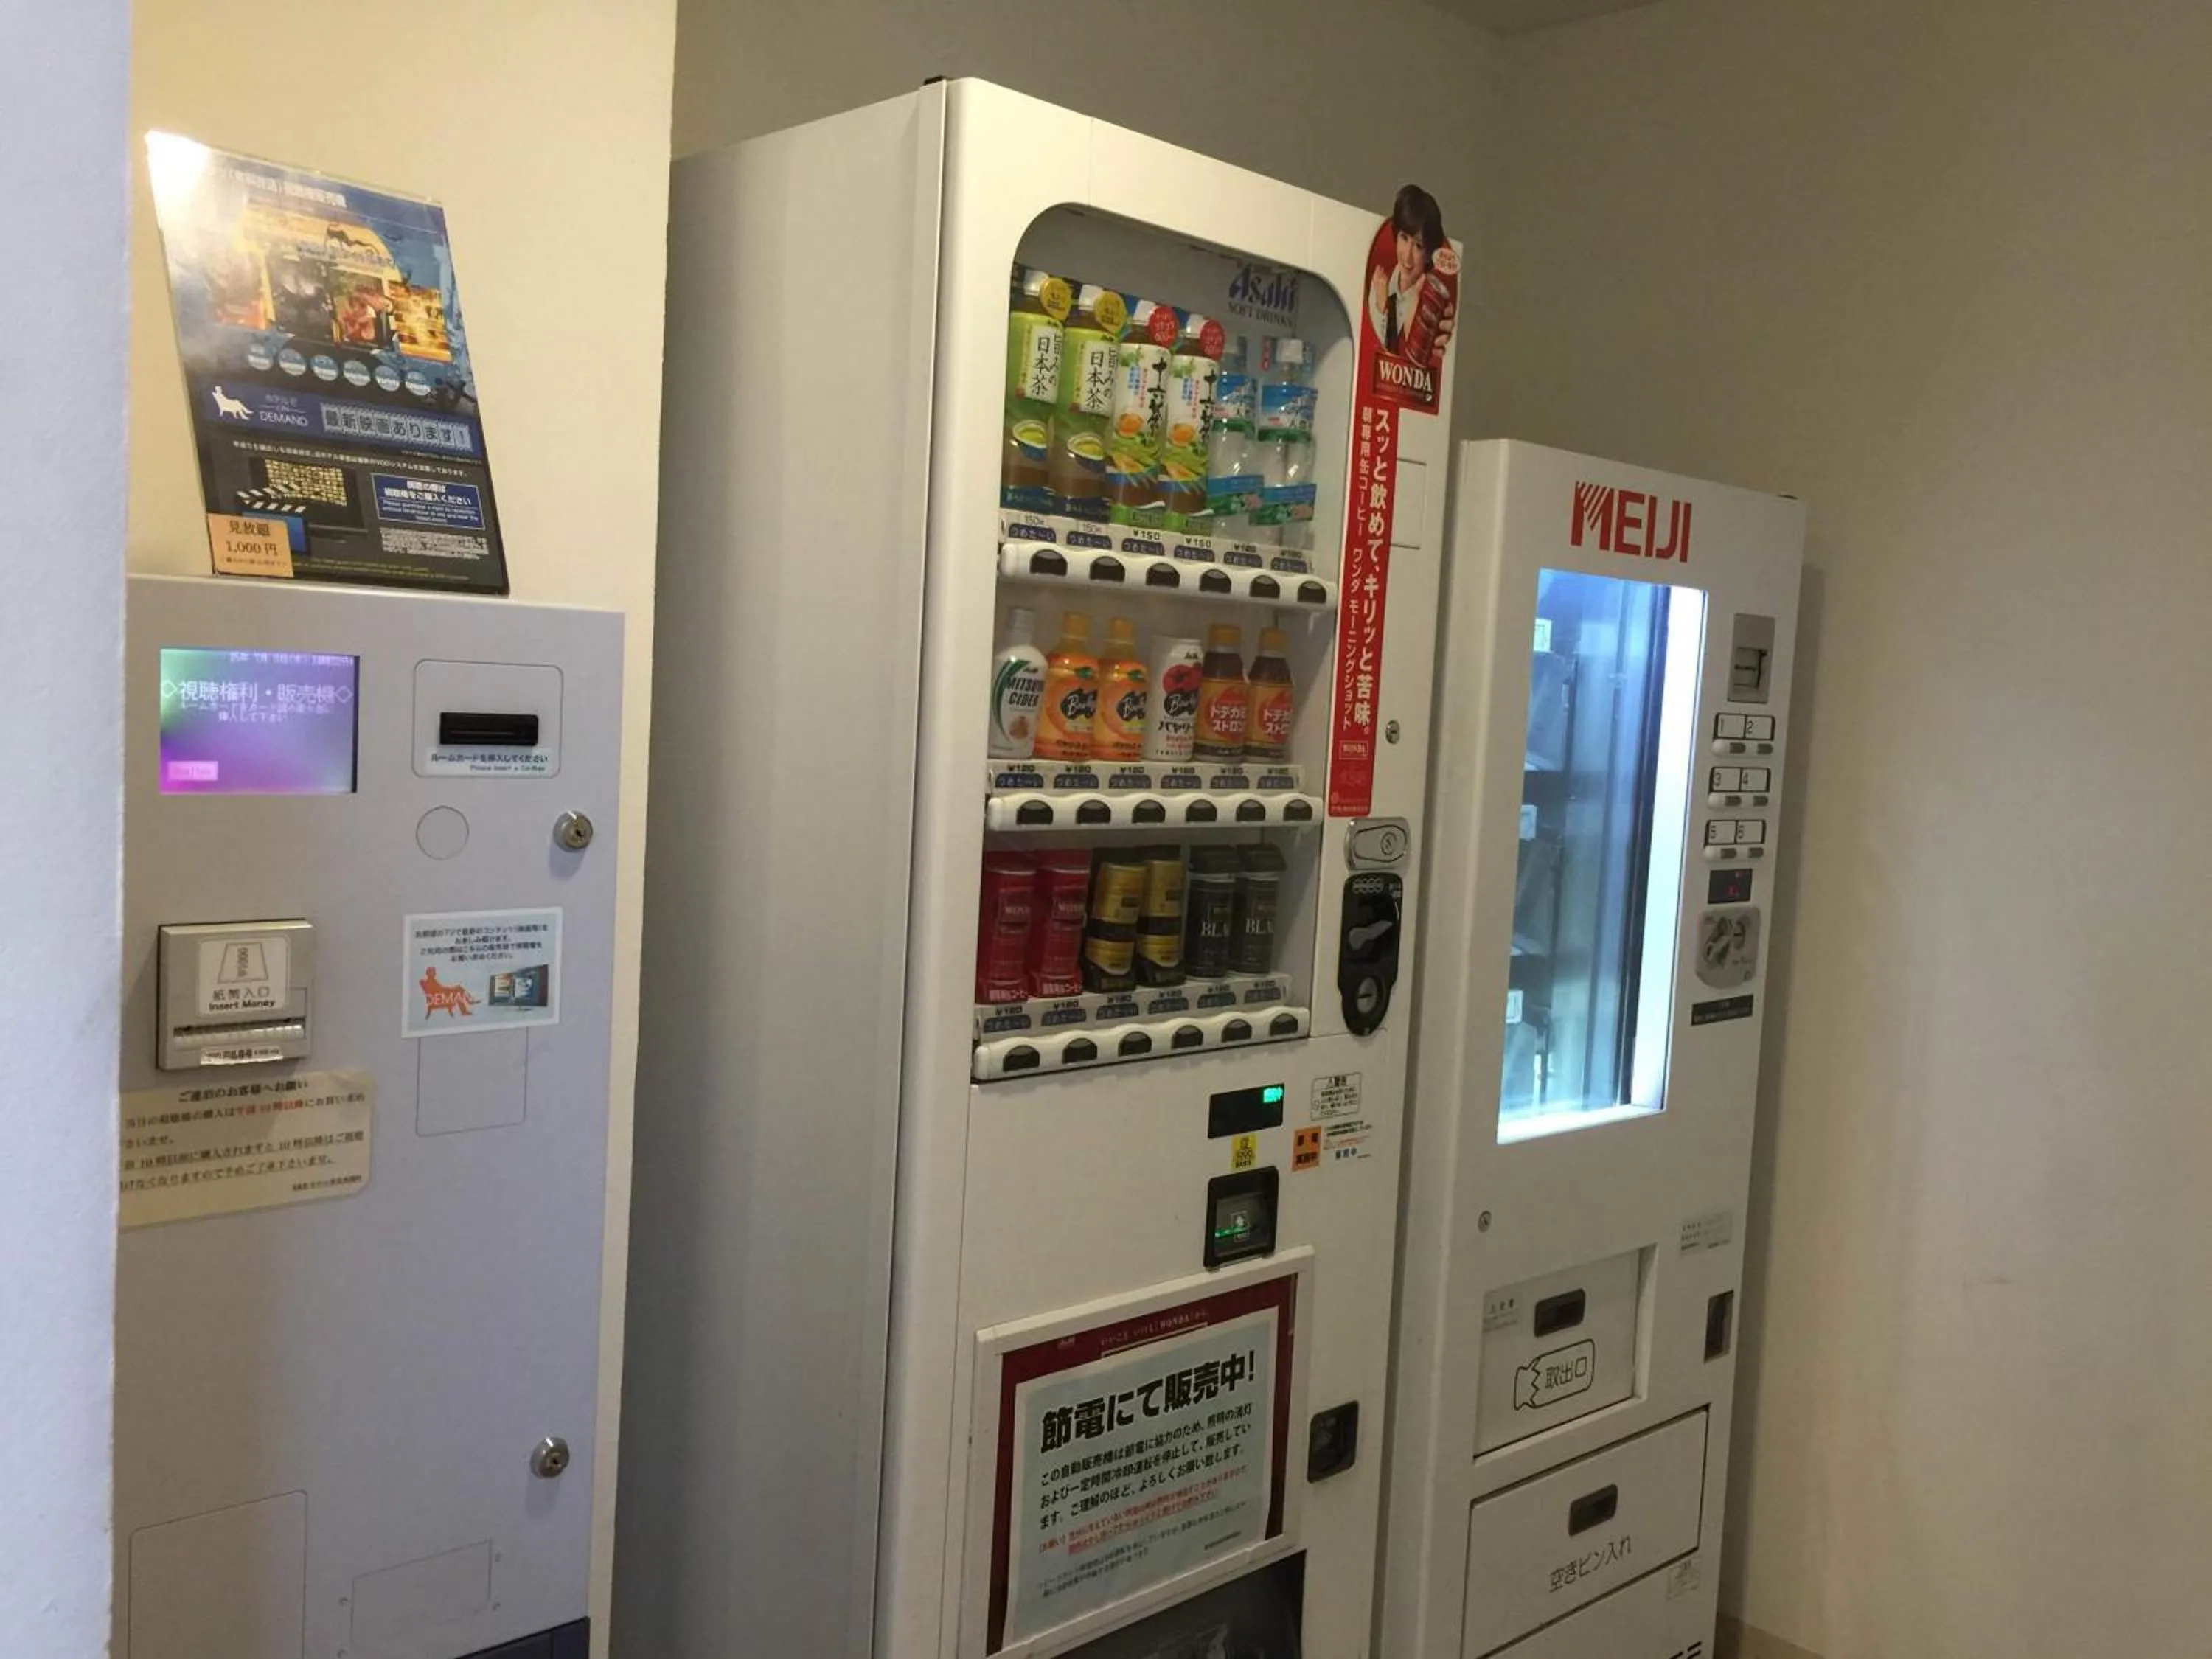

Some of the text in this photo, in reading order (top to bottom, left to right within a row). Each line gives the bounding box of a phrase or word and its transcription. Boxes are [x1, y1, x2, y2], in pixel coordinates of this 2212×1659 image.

[1229, 262, 1297, 313] Asahi
[1228, 301, 1253, 318] SOFT
[1030, 336, 1051, 396] 日本茶
[1086, 351, 1106, 410] 日本茶
[1378, 359, 1433, 392] WONDA
[260, 411, 309, 428] DEMAND
[1571, 480, 1692, 563] MEIJI
[1354, 408, 1391, 735] スッと飲めて、キリッと苦味。
[1747, 720, 1754, 734] 2
[209, 998, 276, 1012] Insert Money
[212, 986, 271, 1001] 紙幣入口
[1545, 1356, 1588, 1390] 取出口
[1040, 1349, 1255, 1454] 節電にて販売中!
[1549, 1535, 1632, 1594] 空きビン入れ
